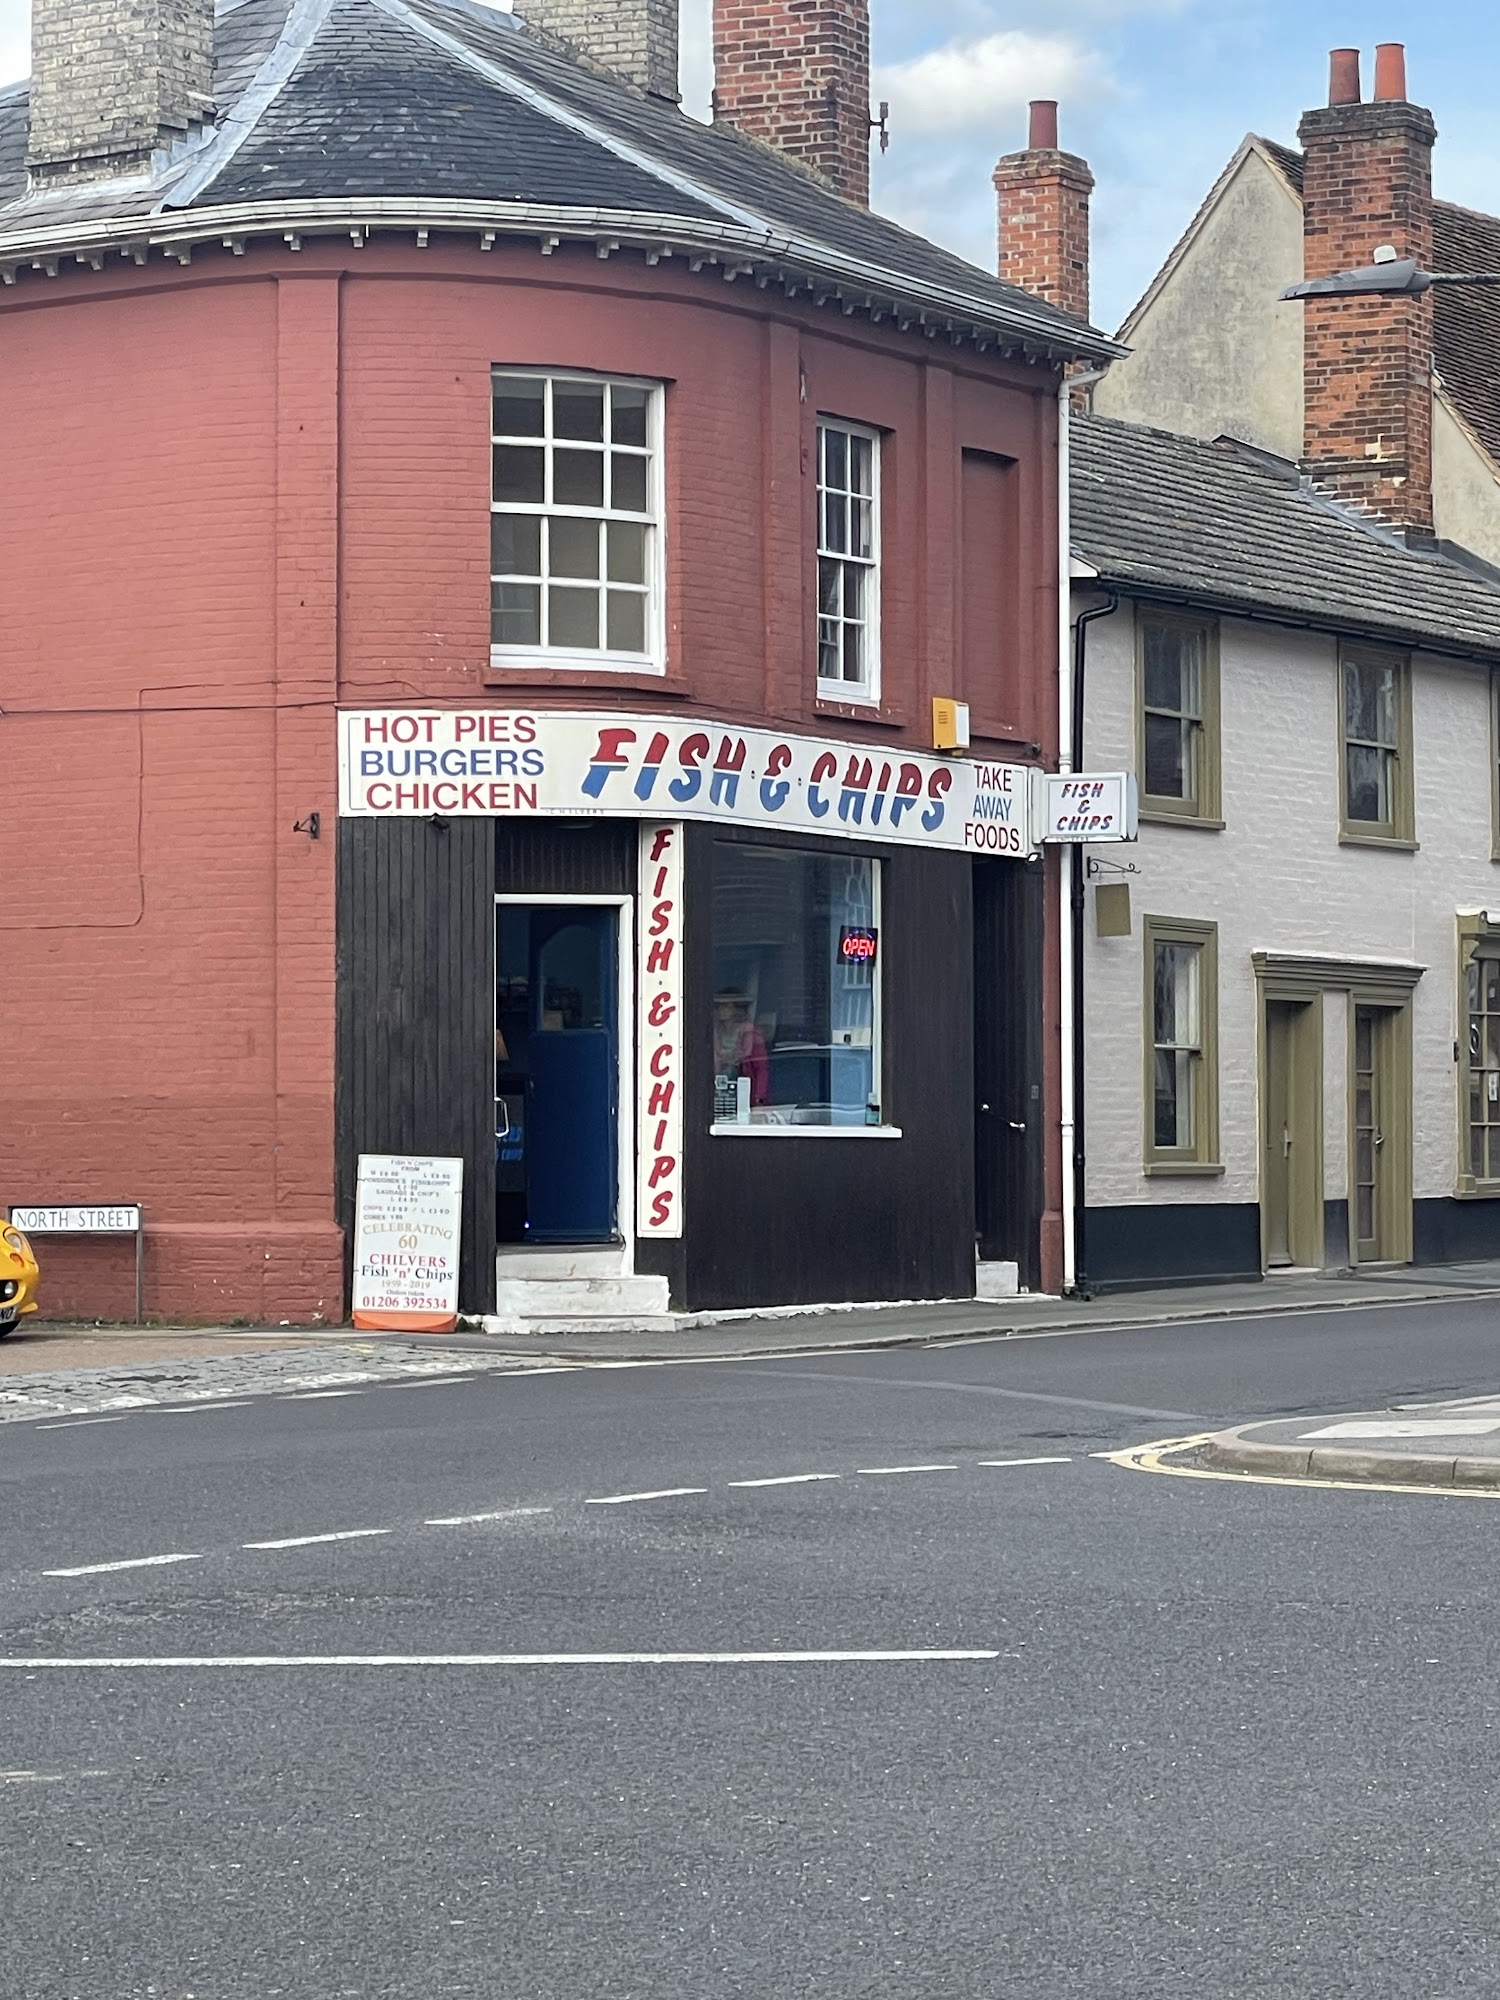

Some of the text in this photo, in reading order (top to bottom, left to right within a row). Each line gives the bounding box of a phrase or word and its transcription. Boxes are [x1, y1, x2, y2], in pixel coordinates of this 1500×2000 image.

[364, 715, 537, 743] HOT PIES
[360, 749, 544, 777] BURGERS
[581, 728, 953, 832] FISH & CHIPS
[974, 764, 1012, 793] TAKE
[366, 782, 538, 811] CHICKEN
[1061, 782, 1104, 798] FISH
[972, 794, 1013, 822] AWAY
[1077, 799, 1091, 814] &
[1056, 815, 1113, 831] CHIPS
[964, 822, 1020, 852] FOODS
[843, 937, 875, 956] OPEN
[646, 828, 676, 1227] FISH & CHIPS
[16, 1210, 134, 1228] NORTH STREET
[362, 1222, 453, 1240] CELEBRATING
[398, 1234, 418, 1249] 60
[369, 1253, 447, 1268] CHILVERS
[361, 1265, 389, 1277] Fish
[415, 1268, 454, 1283] Chips
[381, 1280, 402, 1288] 1959
[409, 1280, 431, 1289] 2019
[362, 1296, 447, 1309] 01206 392534
